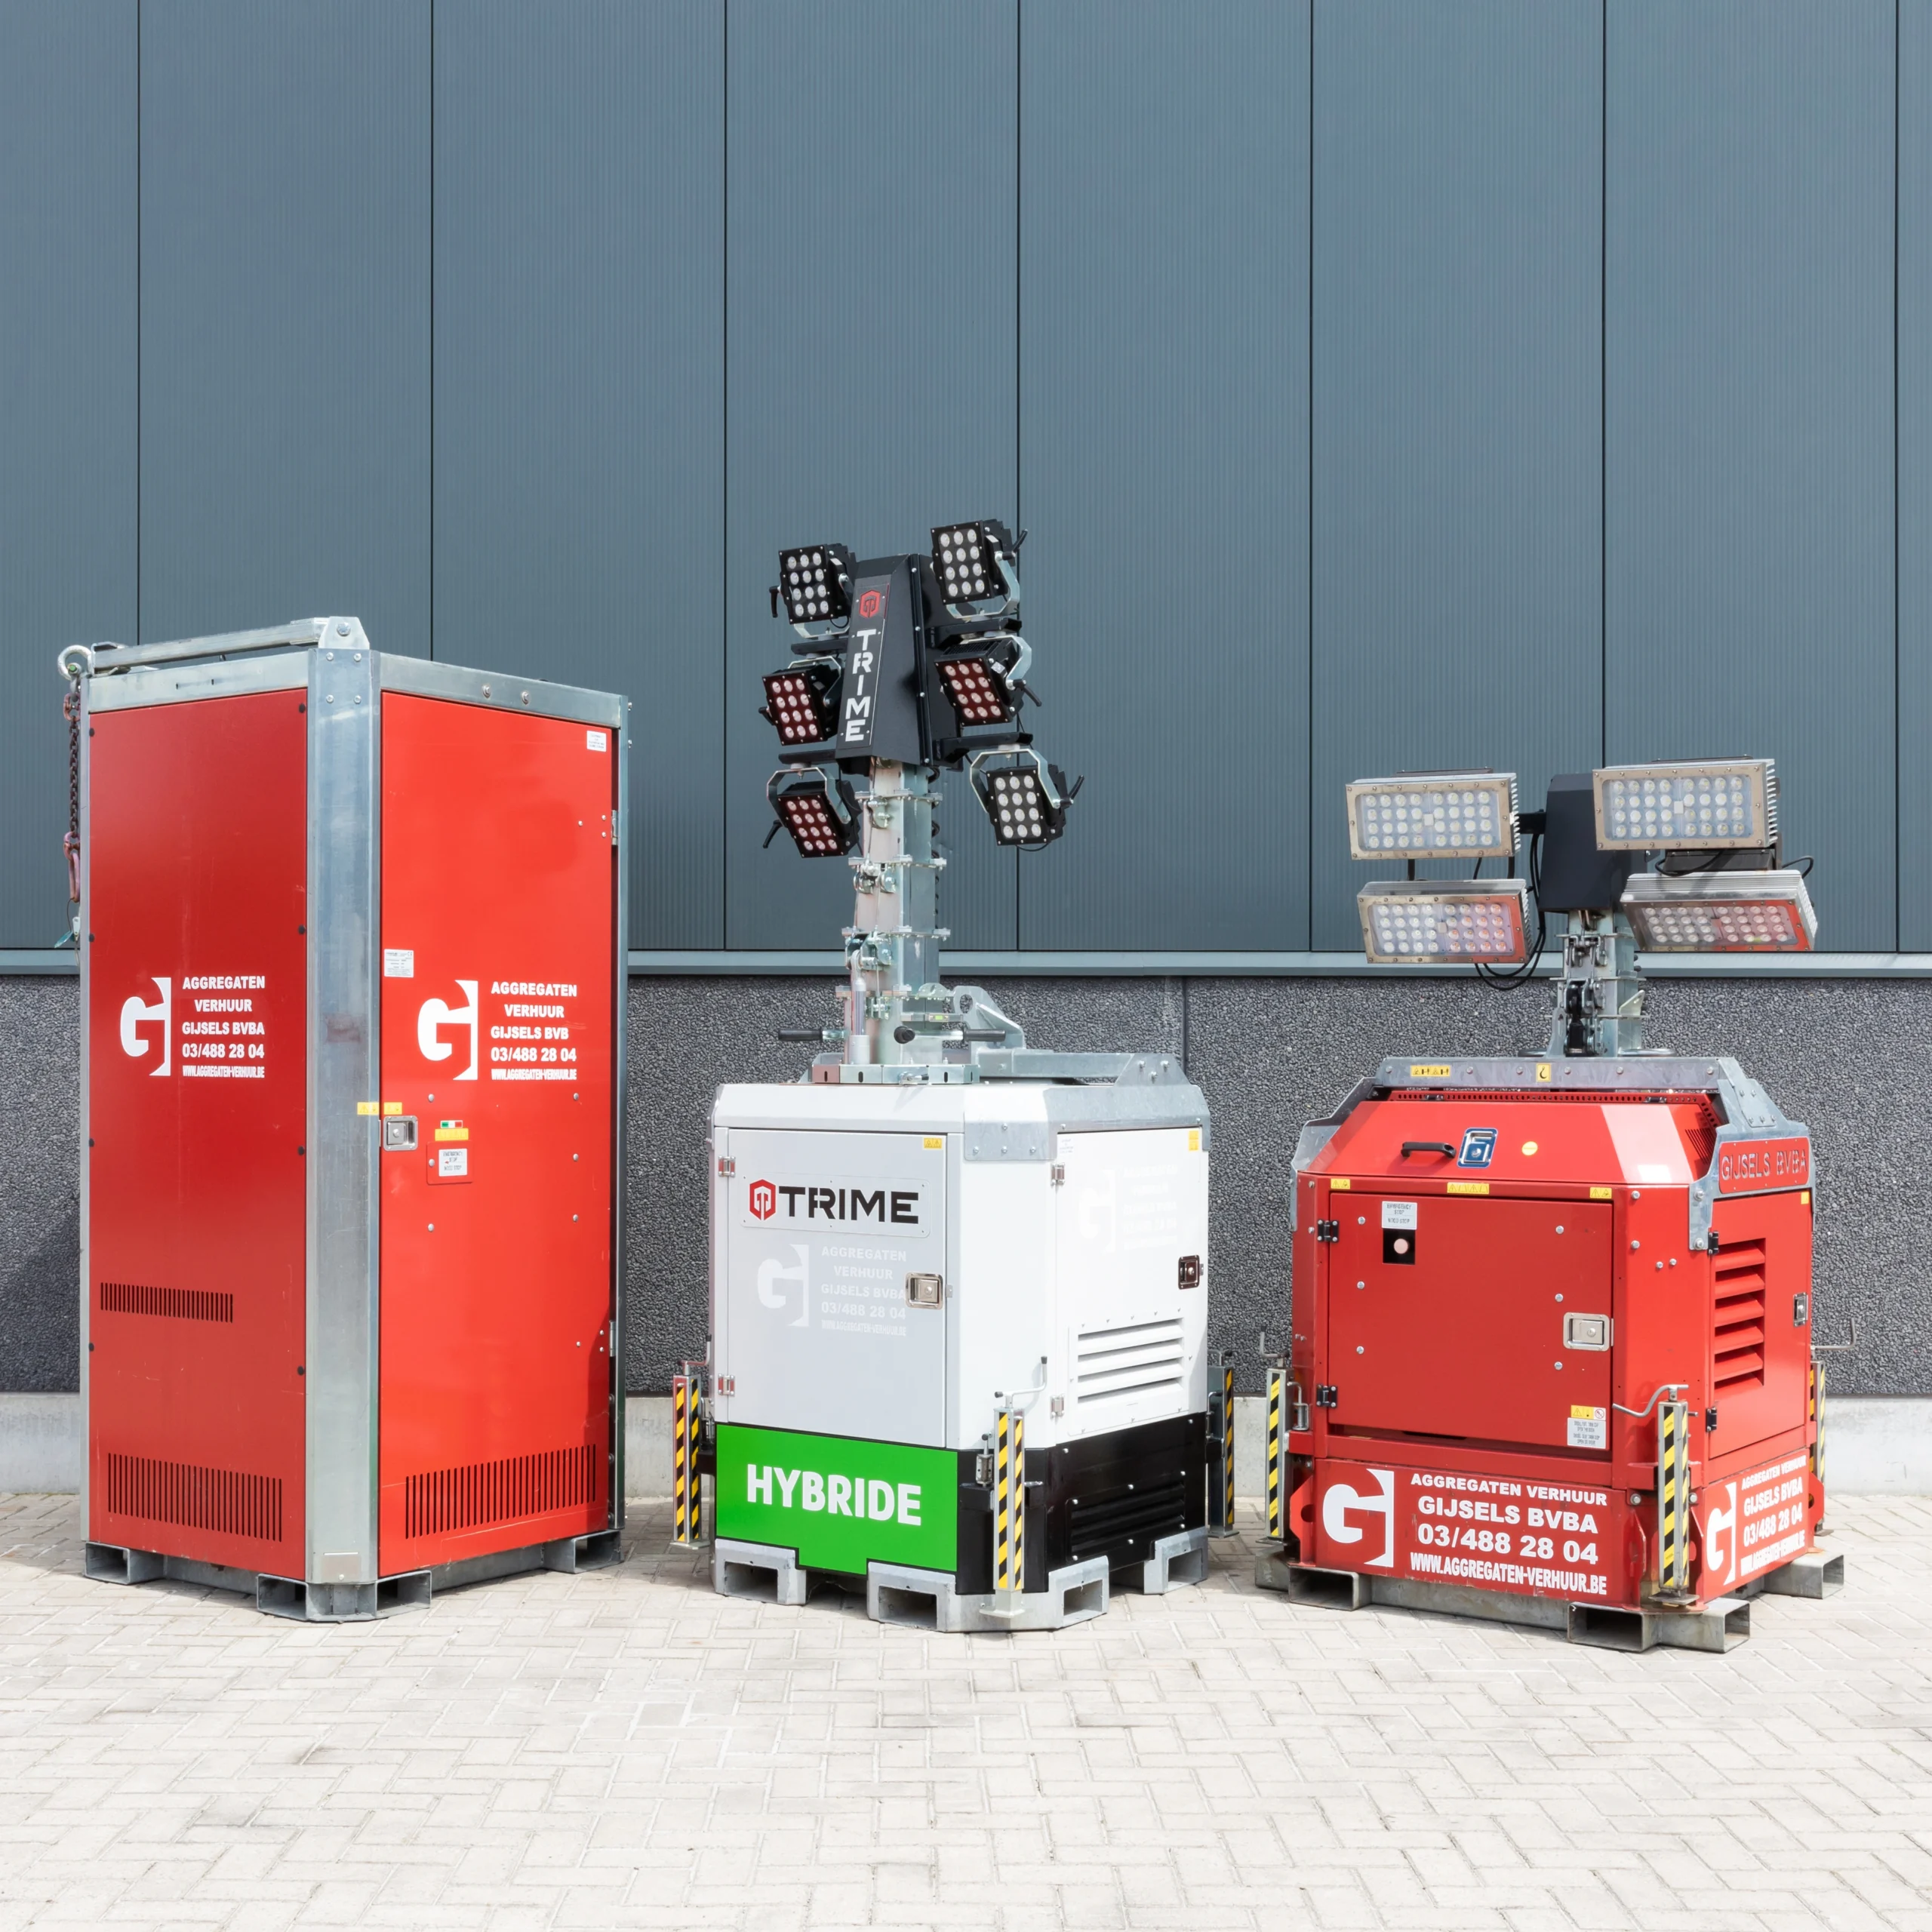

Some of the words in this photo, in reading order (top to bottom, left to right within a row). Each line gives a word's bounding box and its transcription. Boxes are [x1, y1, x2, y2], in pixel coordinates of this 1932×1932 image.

[845, 629, 877, 742] TRIME
[183, 976, 265, 989] AGGREGATEN
[491, 981, 577, 997] AGGREGATEN
[194, 999, 252, 1012] VERHUUR
[504, 1004, 565, 1018] VERHUUR
[182, 1022, 229, 1035] GIJSELS
[232, 1022, 265, 1035] BVBA
[491, 1026, 542, 1039] GIJSELS
[544, 1027, 569, 1040] BVB
[182, 1043, 225, 1058] 03/488
[229, 1044, 245, 1058] 28
[248, 1044, 264, 1058] 04
[491, 1047, 537, 1062] 03/488
[541, 1048, 557, 1062] 28
[560, 1048, 577, 1062] 04
[1721, 1152, 1770, 1180] GIJSELS
[1777, 1149, 1807, 1175] BVBA
[779, 1186, 918, 1224] TRIME
[821, 1246, 906, 1262] AGGREGATEN
[833, 1266, 893, 1280] VERHUUR
[821, 1284, 869, 1297] GIJSELS
[875, 1287, 906, 1300] BVBA
[821, 1302, 866, 1317] 03/488
[869, 1306, 885, 1318] 28
[890, 1307, 906, 1319] 04
[747, 1463, 921, 1526] HYBRIDE
[1411, 1473, 1521, 1497] AGGREGATEN
[1527, 1485, 1607, 1506] VERHUUR
[1744, 1487, 1780, 1517] GIJSELS
[1781, 1477, 1803, 1501] BVBA
[1418, 1496, 1520, 1524] GIJSELS
[1527, 1509, 1598, 1534] BVBA
[1743, 1515, 1776, 1547] 03/488
[1778, 1508, 1789, 1532] 28
[1791, 1502, 1802, 1525] 04
[1418, 1523, 1511, 1554] 03/488
[1520, 1536, 1553, 1559] 28
[1563, 1540, 1598, 1565] 04
[1411, 1552, 1607, 1595] WWW.AGGREGATEN-VERHUUR.BE
